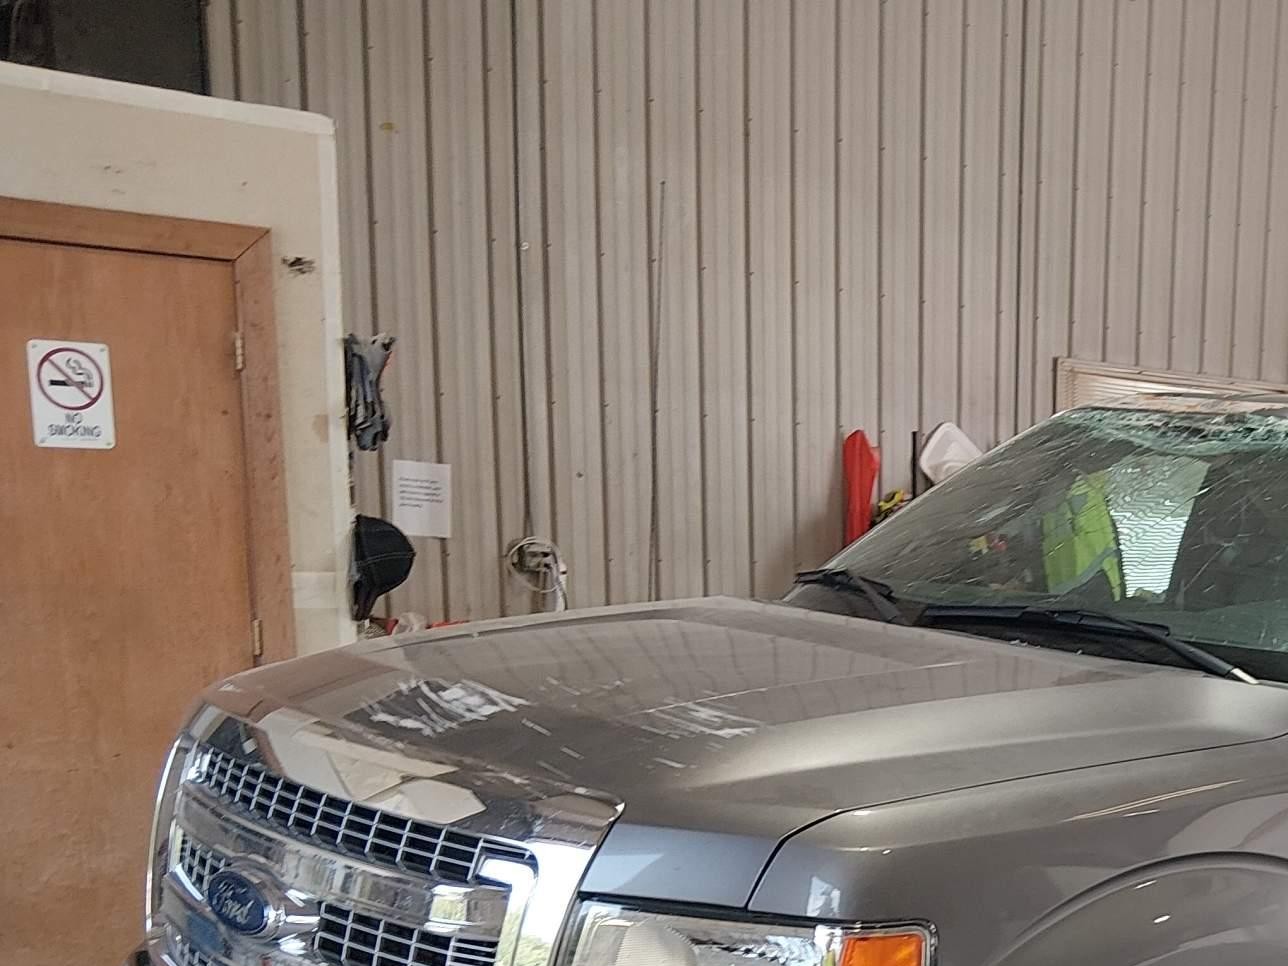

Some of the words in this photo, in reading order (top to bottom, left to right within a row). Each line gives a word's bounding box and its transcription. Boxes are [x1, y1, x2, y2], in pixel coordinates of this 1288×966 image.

[65, 412, 83, 424] NO
[48, 423, 102, 438] SMOKING
[212, 879, 255, 925] Ford
